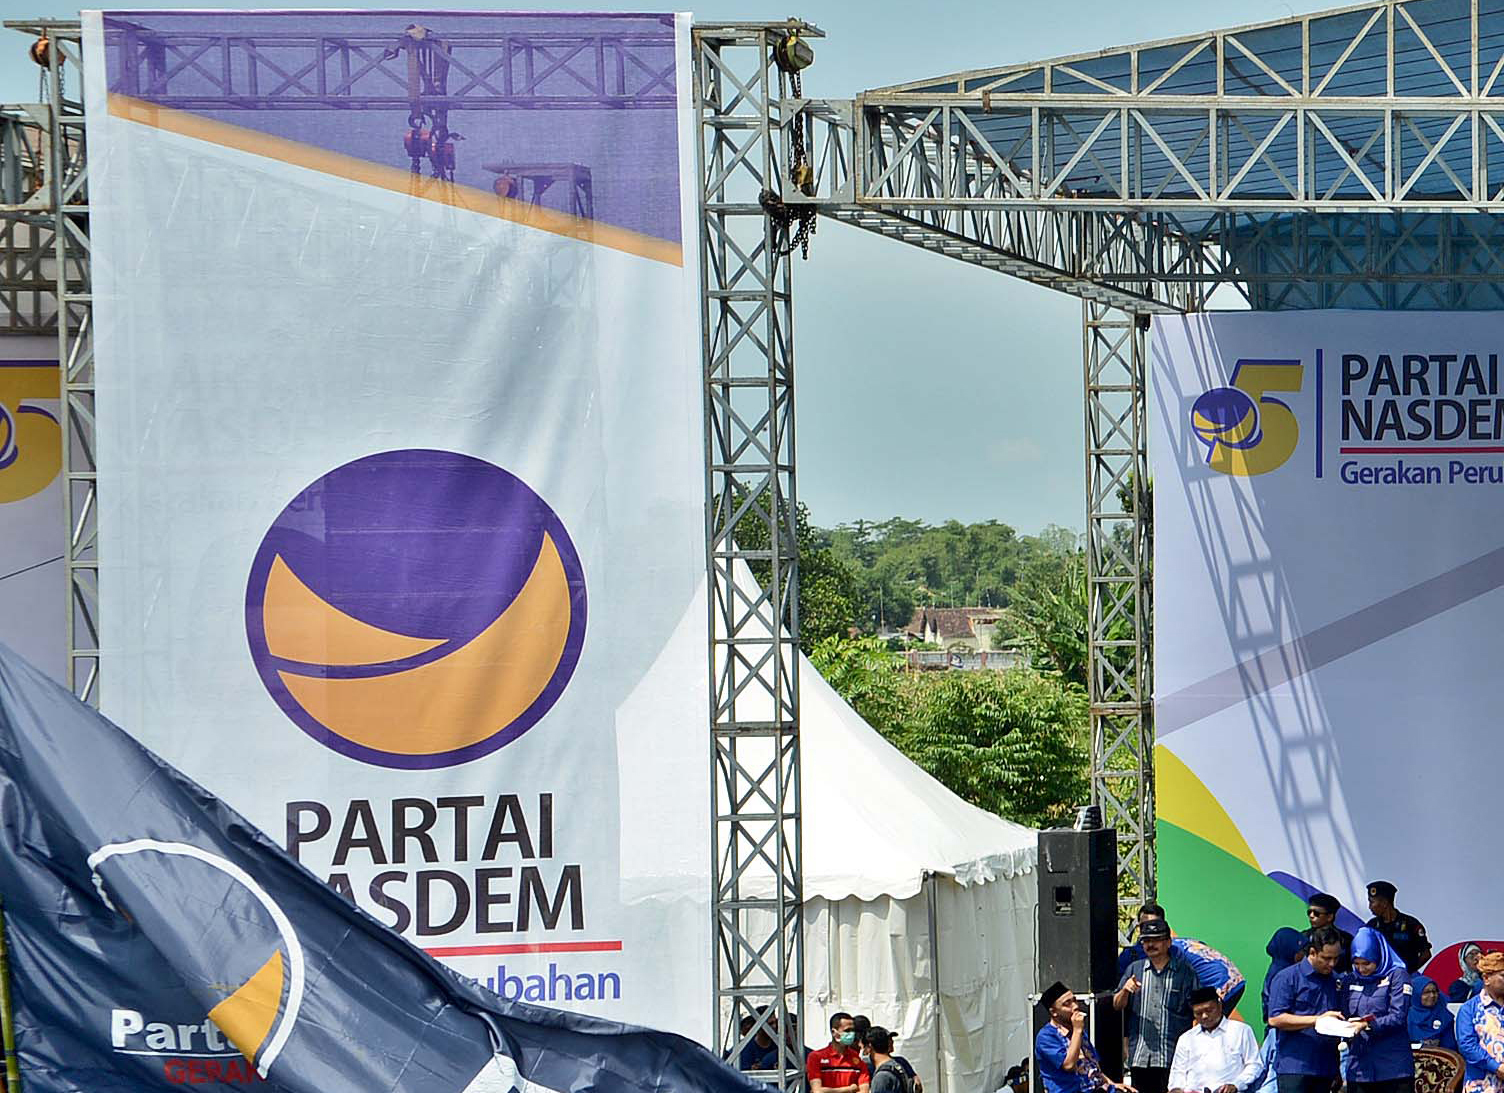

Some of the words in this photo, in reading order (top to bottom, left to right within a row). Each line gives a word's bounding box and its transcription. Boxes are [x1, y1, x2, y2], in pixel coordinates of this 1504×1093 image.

[1340, 353, 1498, 396] PARTAI
[1340, 460, 1442, 484] Gerakan
[286, 792, 554, 864] PARTAI
[328, 864, 585, 934] ASDEM
[470, 962, 621, 1001] ubahan
[110, 1008, 238, 1053] Part
